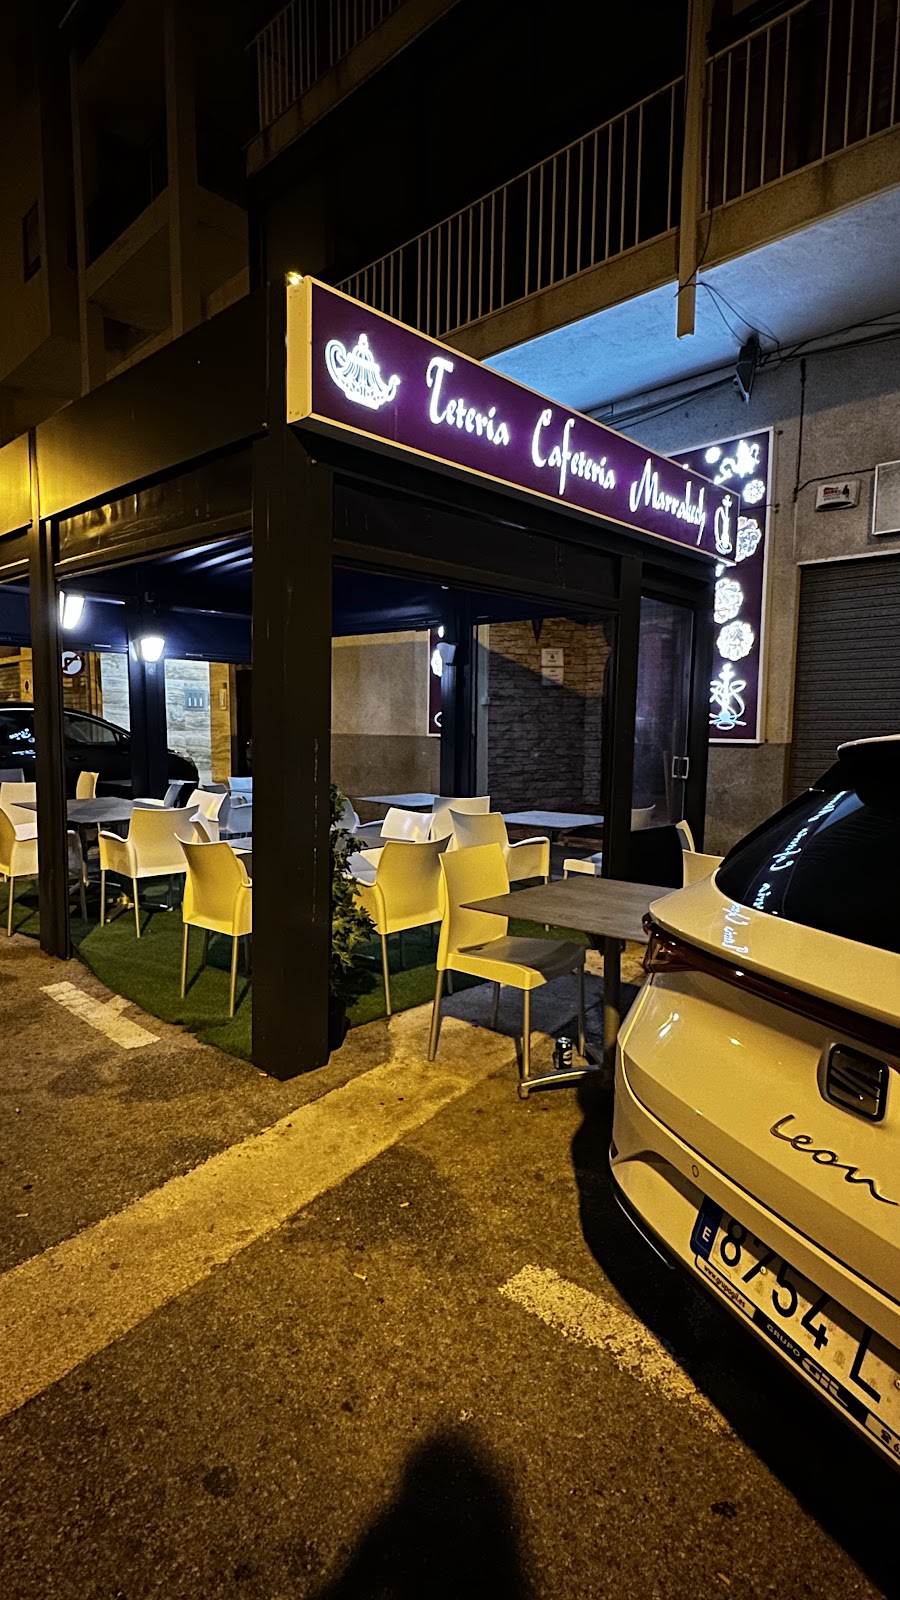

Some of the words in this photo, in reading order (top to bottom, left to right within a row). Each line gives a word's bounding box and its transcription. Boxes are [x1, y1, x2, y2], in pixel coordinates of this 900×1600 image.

[702, 1226, 712, 1242] E
[720, 1218, 829, 1351] 8754
[766, 1323, 801, 1357] GRUPO
